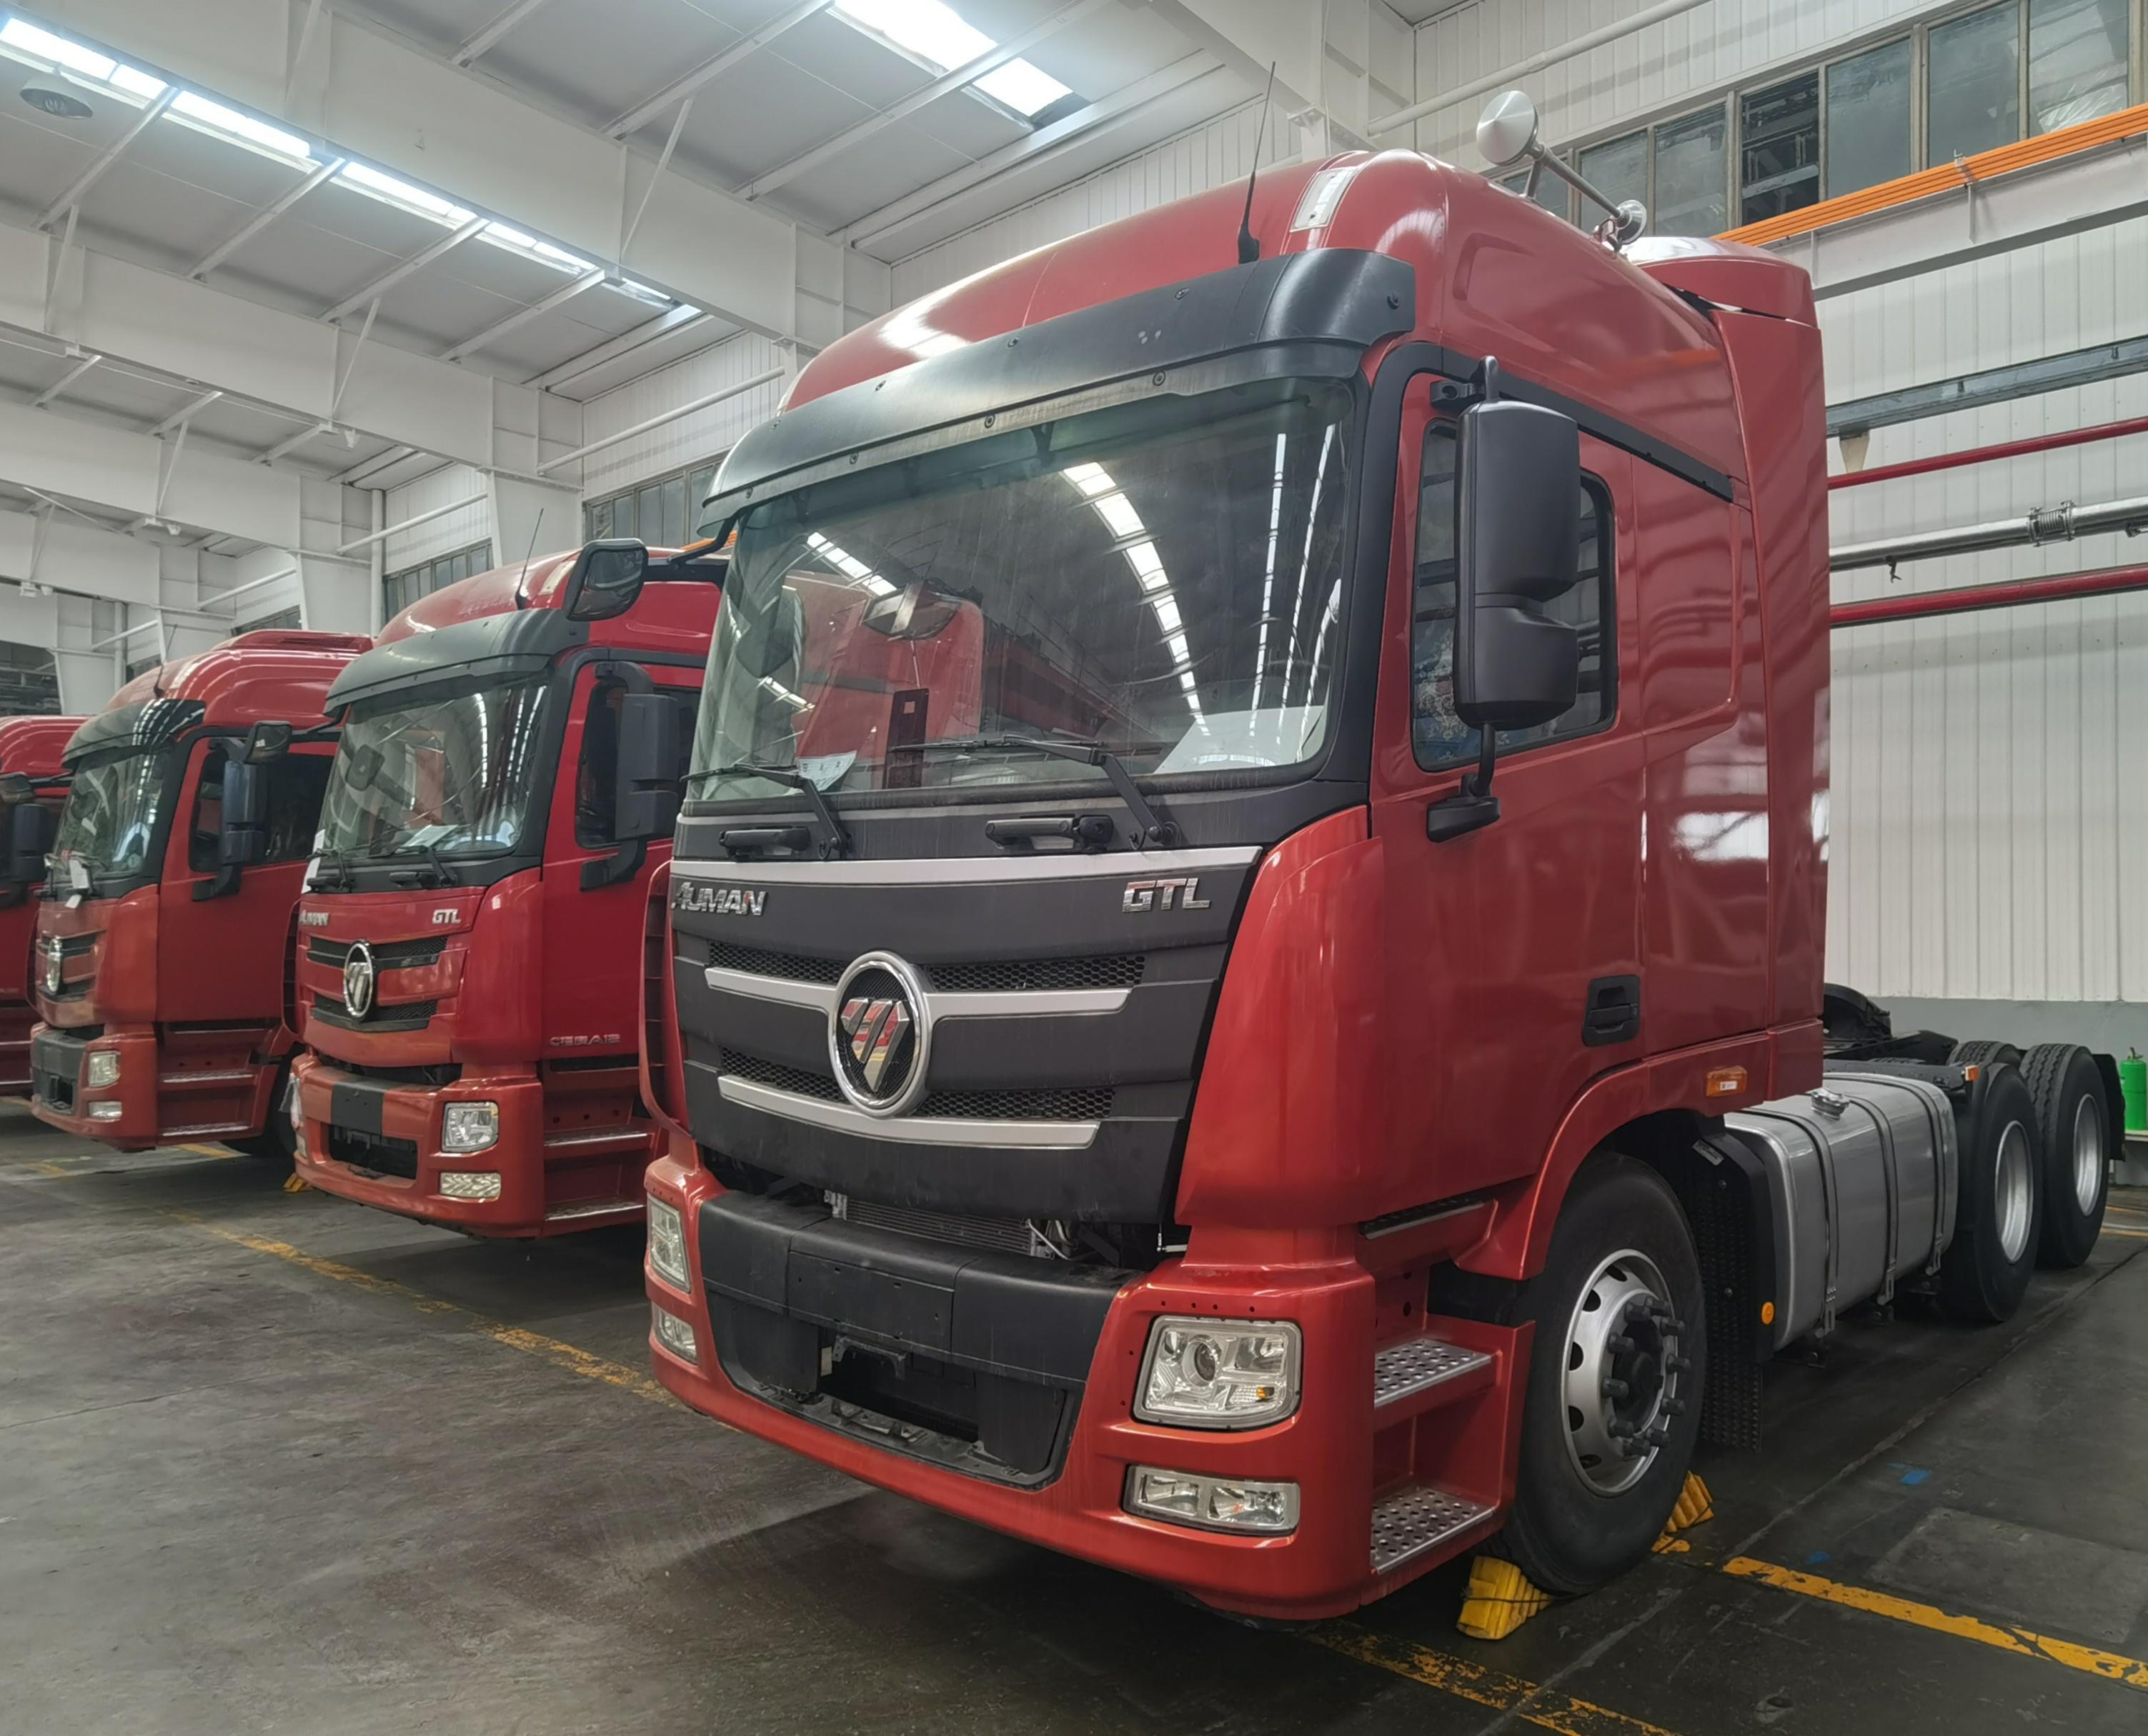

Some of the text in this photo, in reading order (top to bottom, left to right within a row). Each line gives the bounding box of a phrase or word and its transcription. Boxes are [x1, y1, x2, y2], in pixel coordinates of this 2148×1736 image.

[670, 882, 767, 916] AUMAN
[1122, 877, 1211, 912] GTL
[432, 909, 462, 924] GTL
